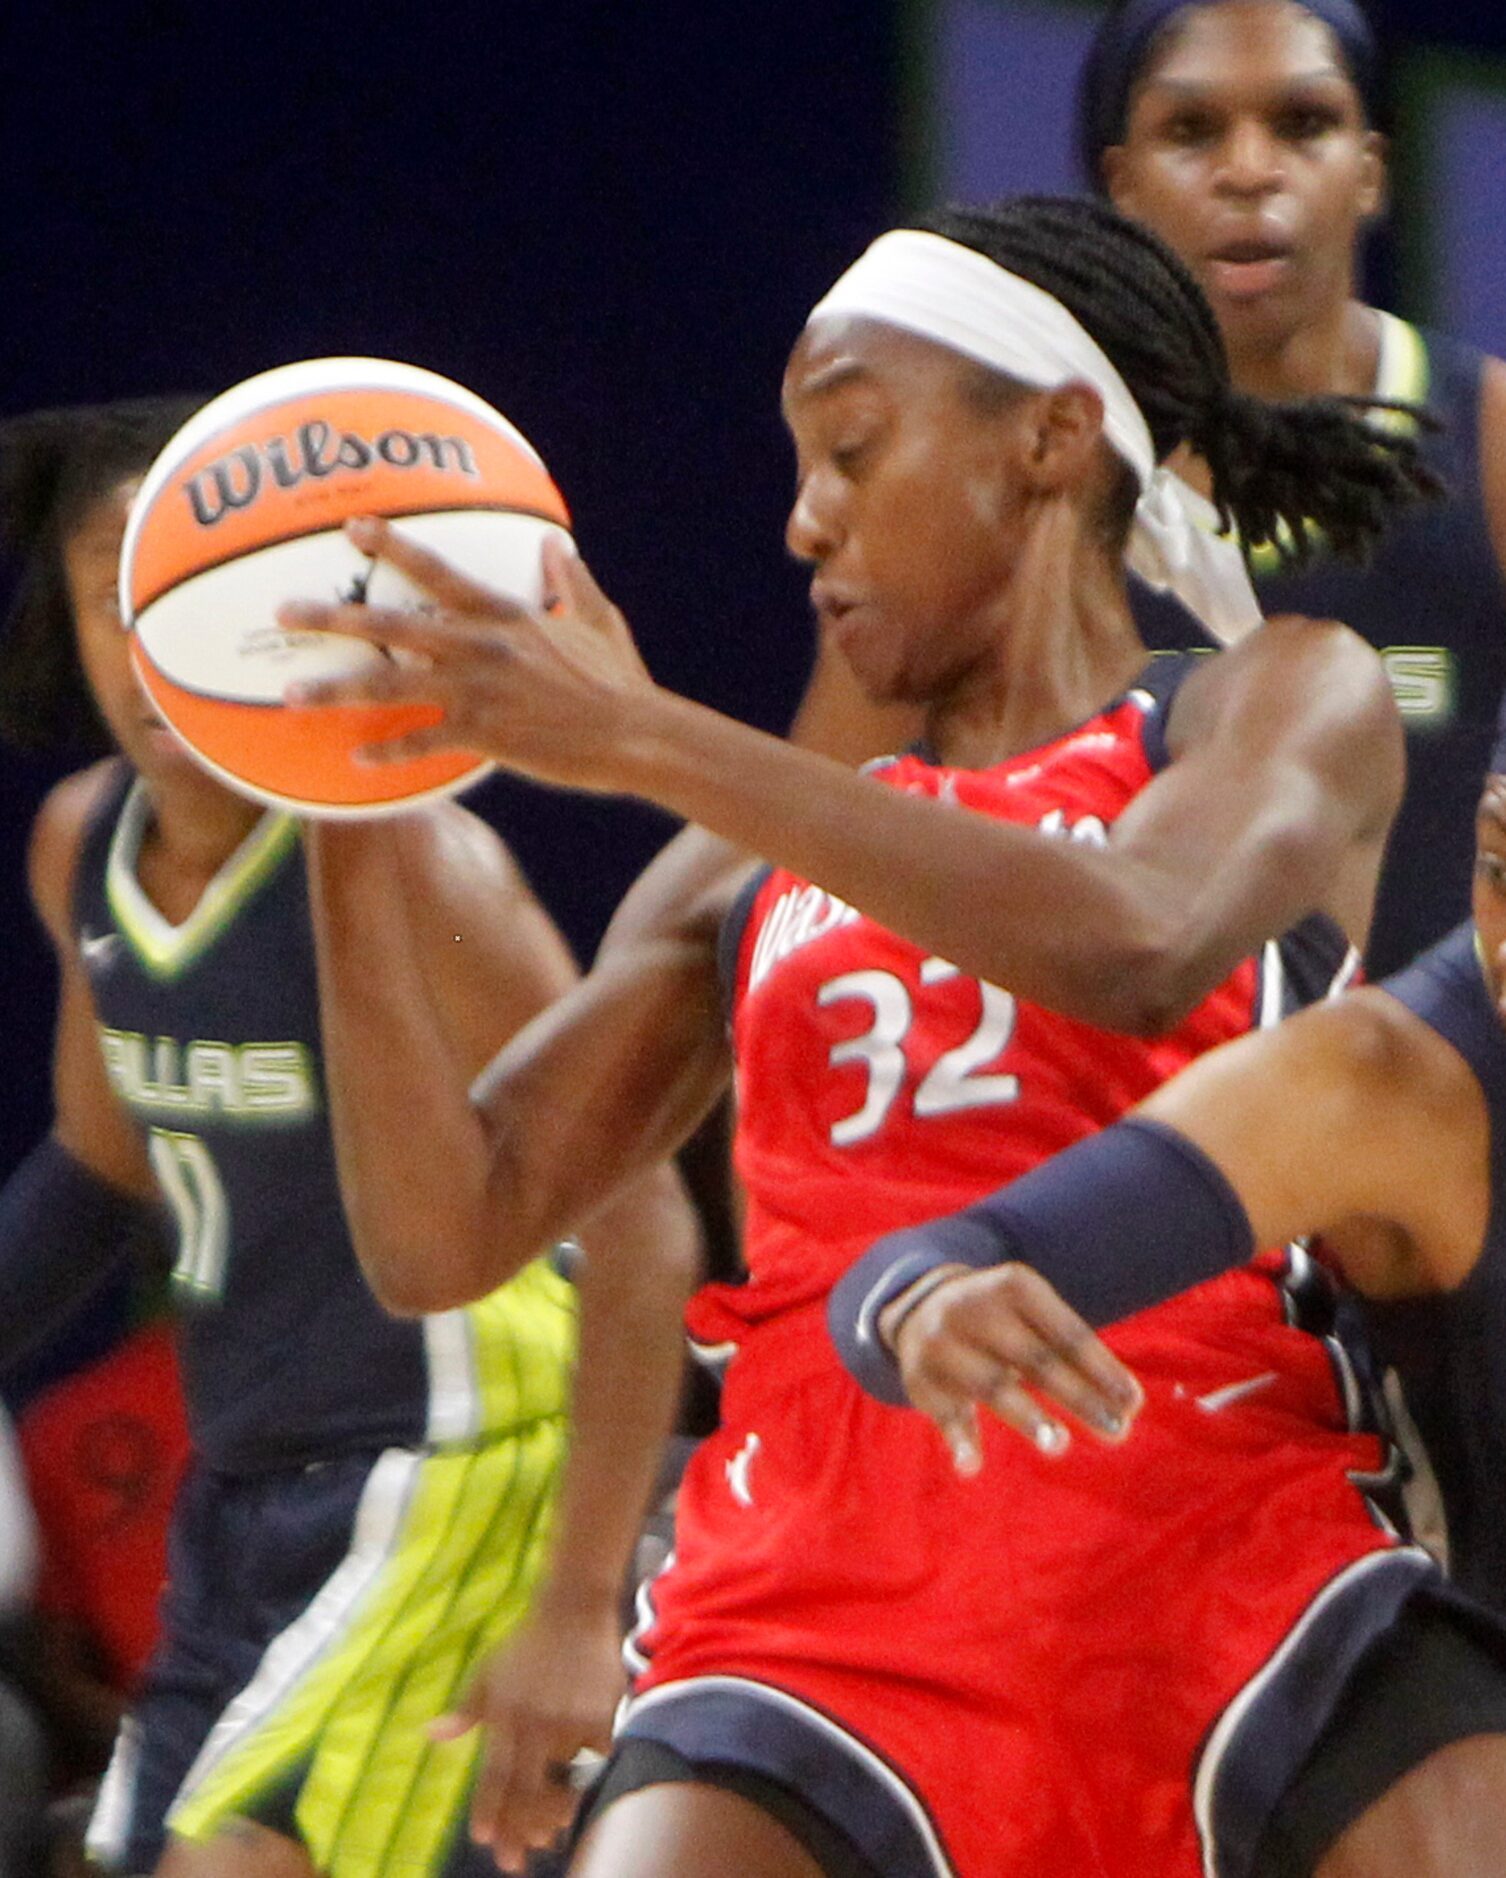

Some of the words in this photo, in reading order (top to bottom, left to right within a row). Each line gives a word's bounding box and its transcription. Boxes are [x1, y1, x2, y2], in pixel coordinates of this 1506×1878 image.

[184, 420, 478, 525] Wilson
[100, 1028, 311, 1112] ALLAS
[816, 956, 1018, 1147] 32
